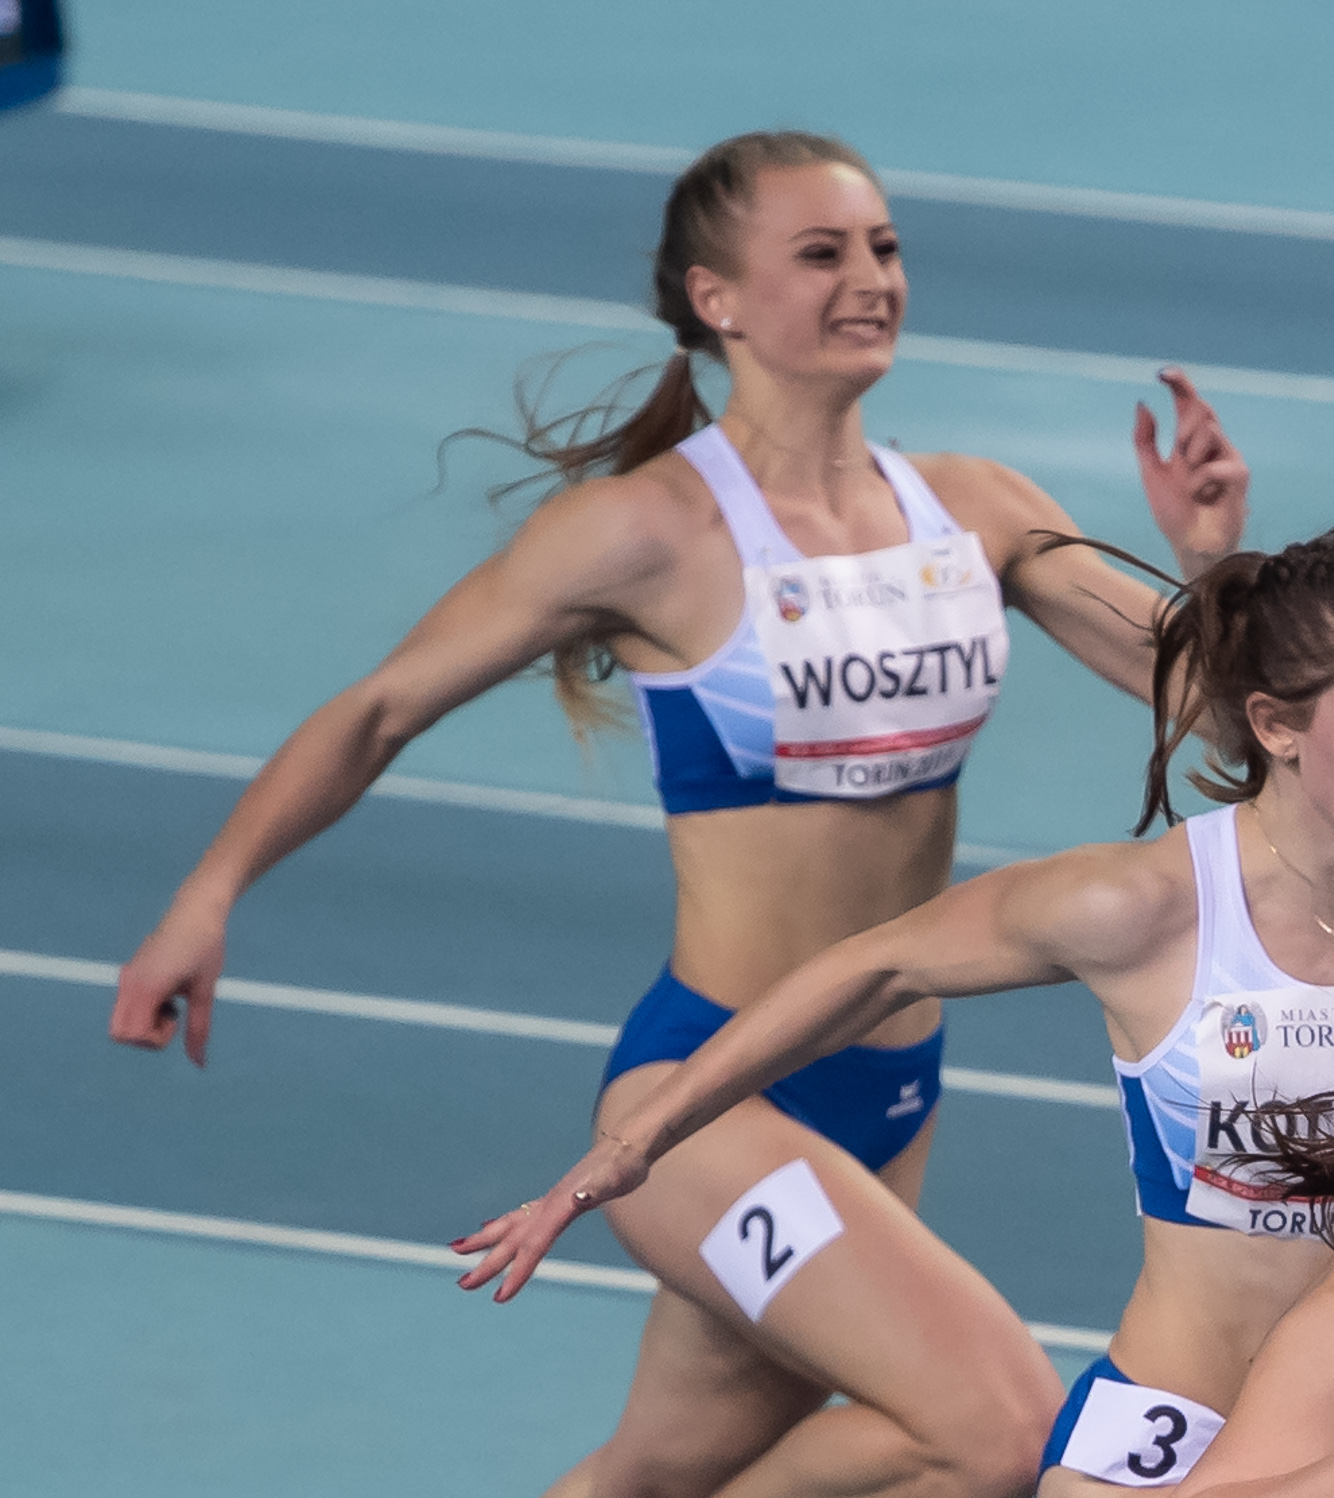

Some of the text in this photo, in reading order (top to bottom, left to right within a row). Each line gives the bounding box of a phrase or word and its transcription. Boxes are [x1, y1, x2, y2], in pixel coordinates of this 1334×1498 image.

[779, 636, 998, 710] WOSZTYL
[738, 1206, 795, 1282] 2
[1126, 1403, 1189, 1480] 3
